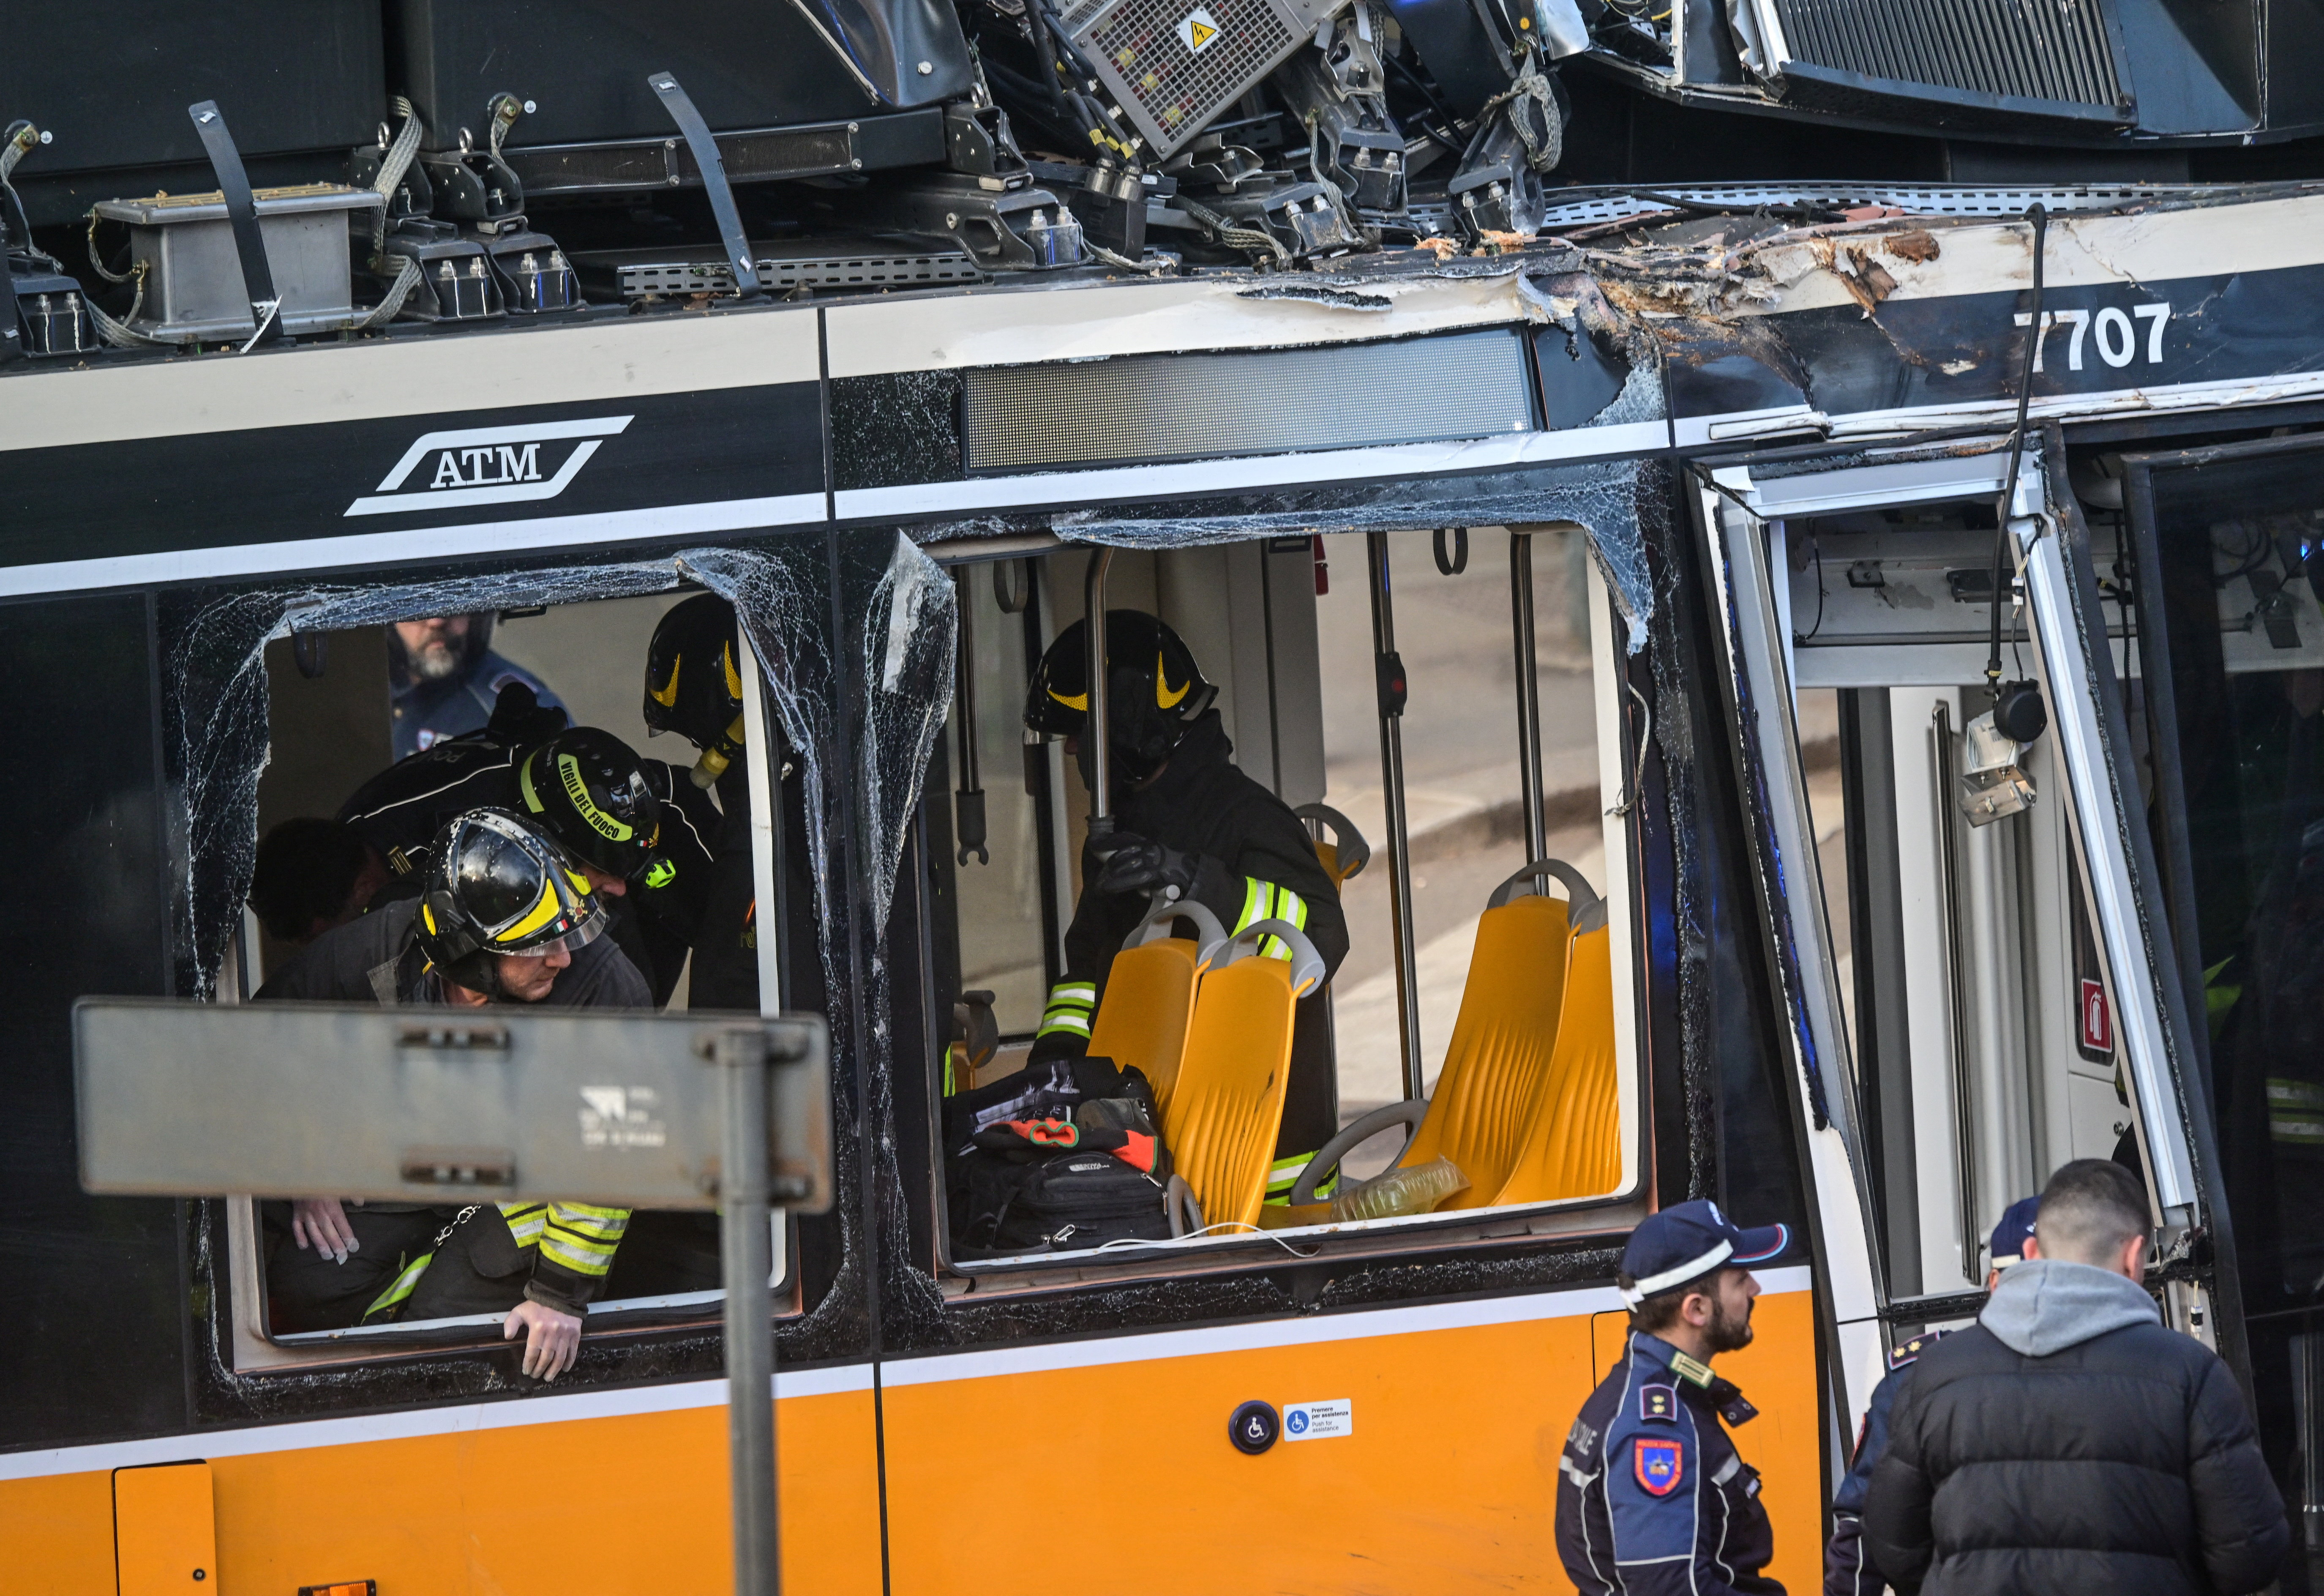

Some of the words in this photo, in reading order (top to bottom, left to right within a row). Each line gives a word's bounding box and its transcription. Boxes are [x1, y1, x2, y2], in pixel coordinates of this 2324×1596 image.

[2014, 301, 2171, 373] 7707
[430, 443, 542, 489] ATM
[561, 762, 580, 793] VIGILI
[575, 793, 592, 814] DEL
[588, 811, 619, 839] FUOCO
